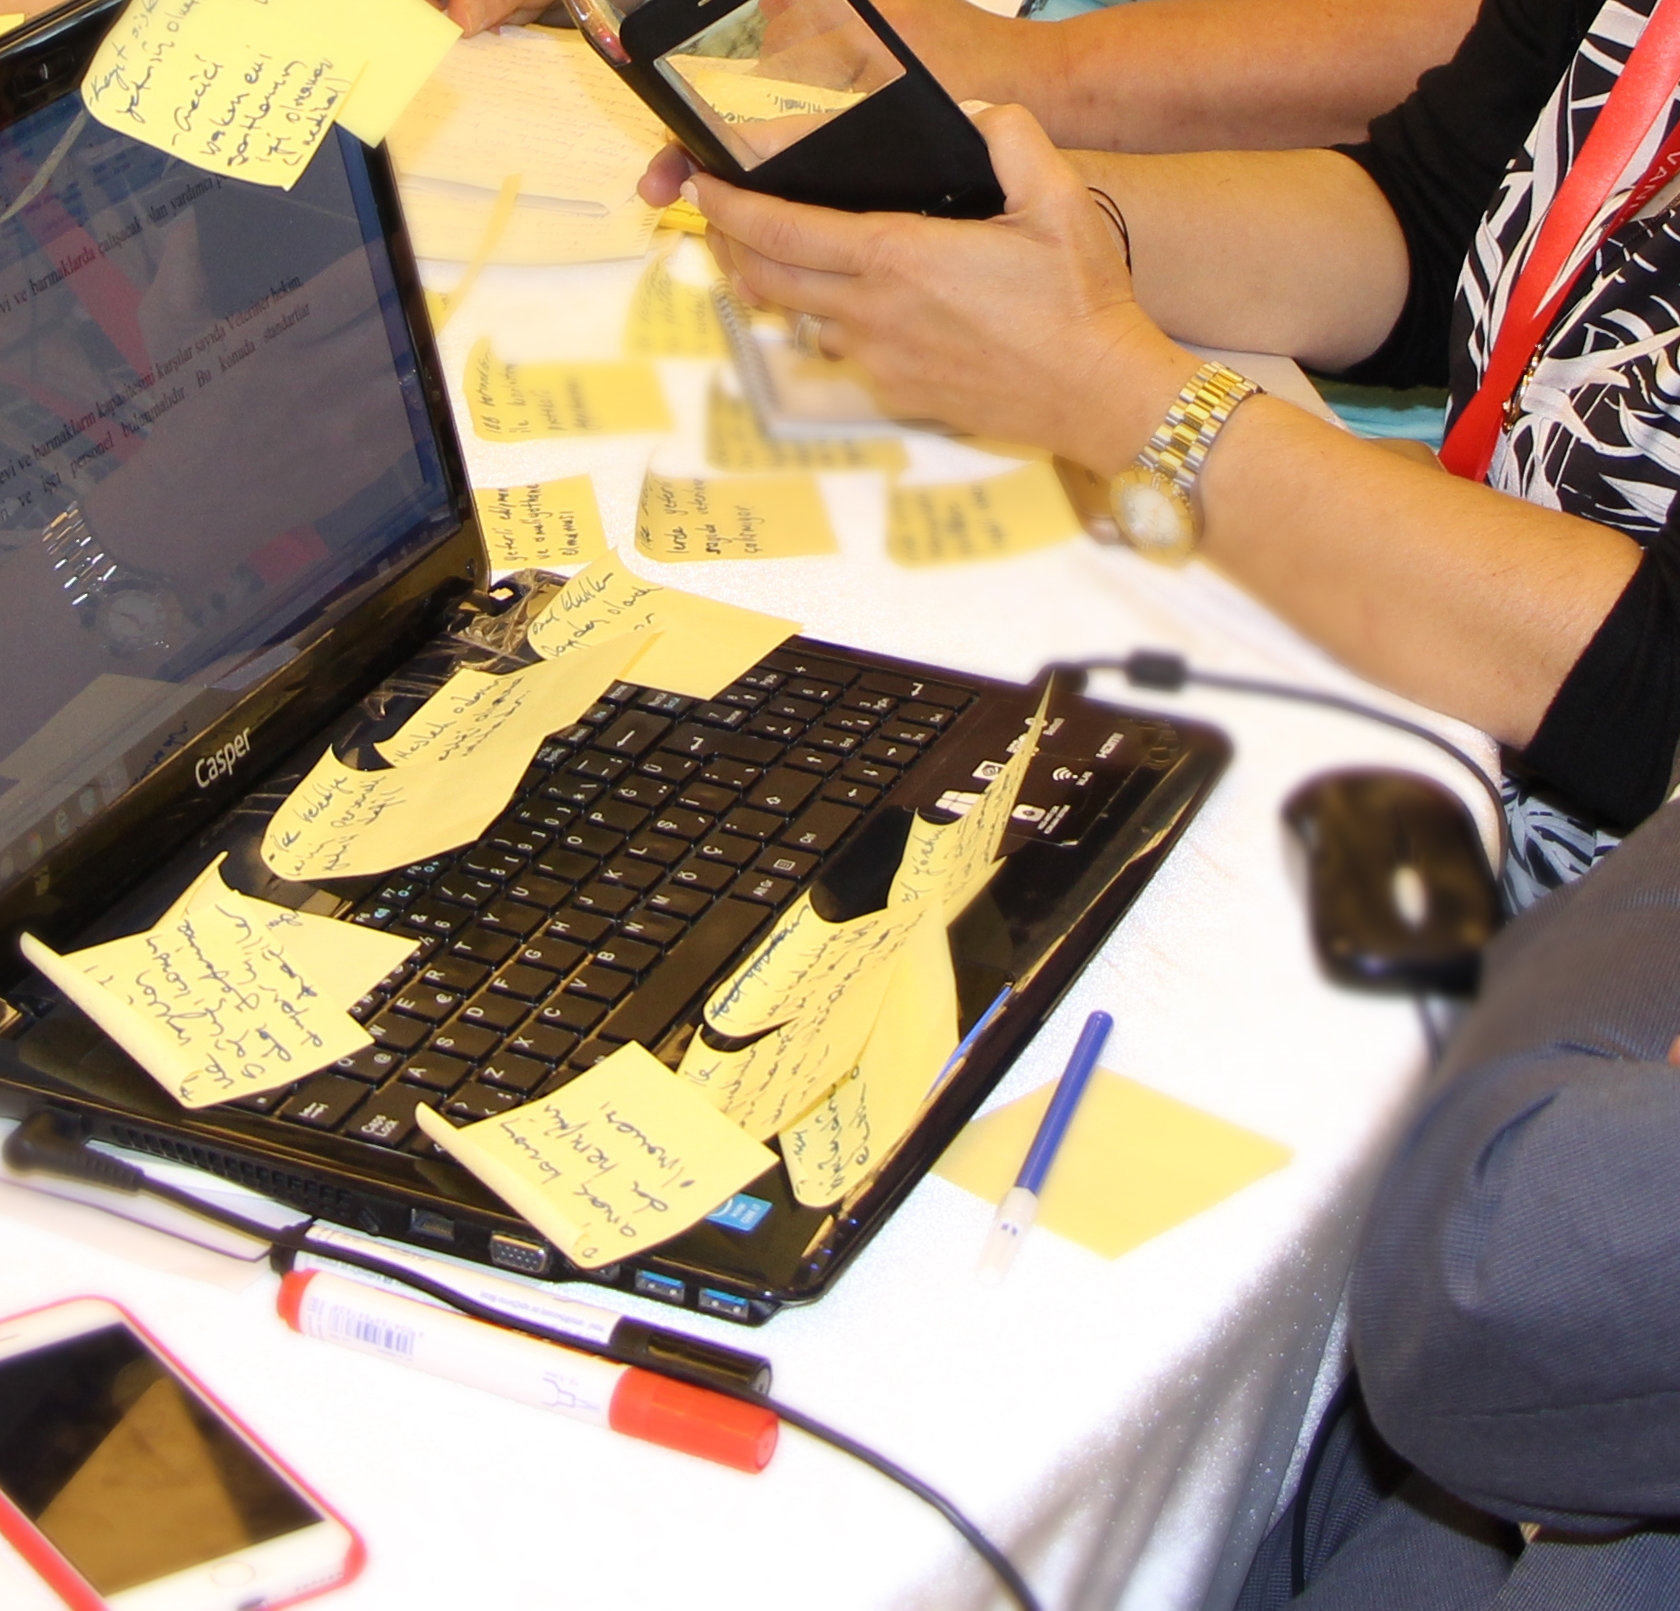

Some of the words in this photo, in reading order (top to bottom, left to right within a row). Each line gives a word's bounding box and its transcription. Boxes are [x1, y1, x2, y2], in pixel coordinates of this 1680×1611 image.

[194, 728, 251, 789] Casper
[409, 1066, 427, 1079] A
[436, 1036, 455, 1048] S
[465, 1006, 485, 1018] D
[494, 977, 509, 990] F
[524, 948, 542, 960] G
[551, 920, 570, 932] H
[578, 894, 595, 906] J
[603, 868, 623, 881] K
[629, 846, 648, 857] L
[425, 969, 446, 981] R
[453, 941, 473, 953] T
[483, 913, 501, 925] Y
[511, 886, 530, 898] U
[590, 811, 606, 823] P
[486, 1067, 504, 1080] Z
[515, 1036, 534, 1048] X
[545, 1007, 562, 1019] C
[571, 978, 589, 989] V
[597, 950, 616, 962] B
[625, 921, 645, 933] N
[652, 894, 671, 906] M
